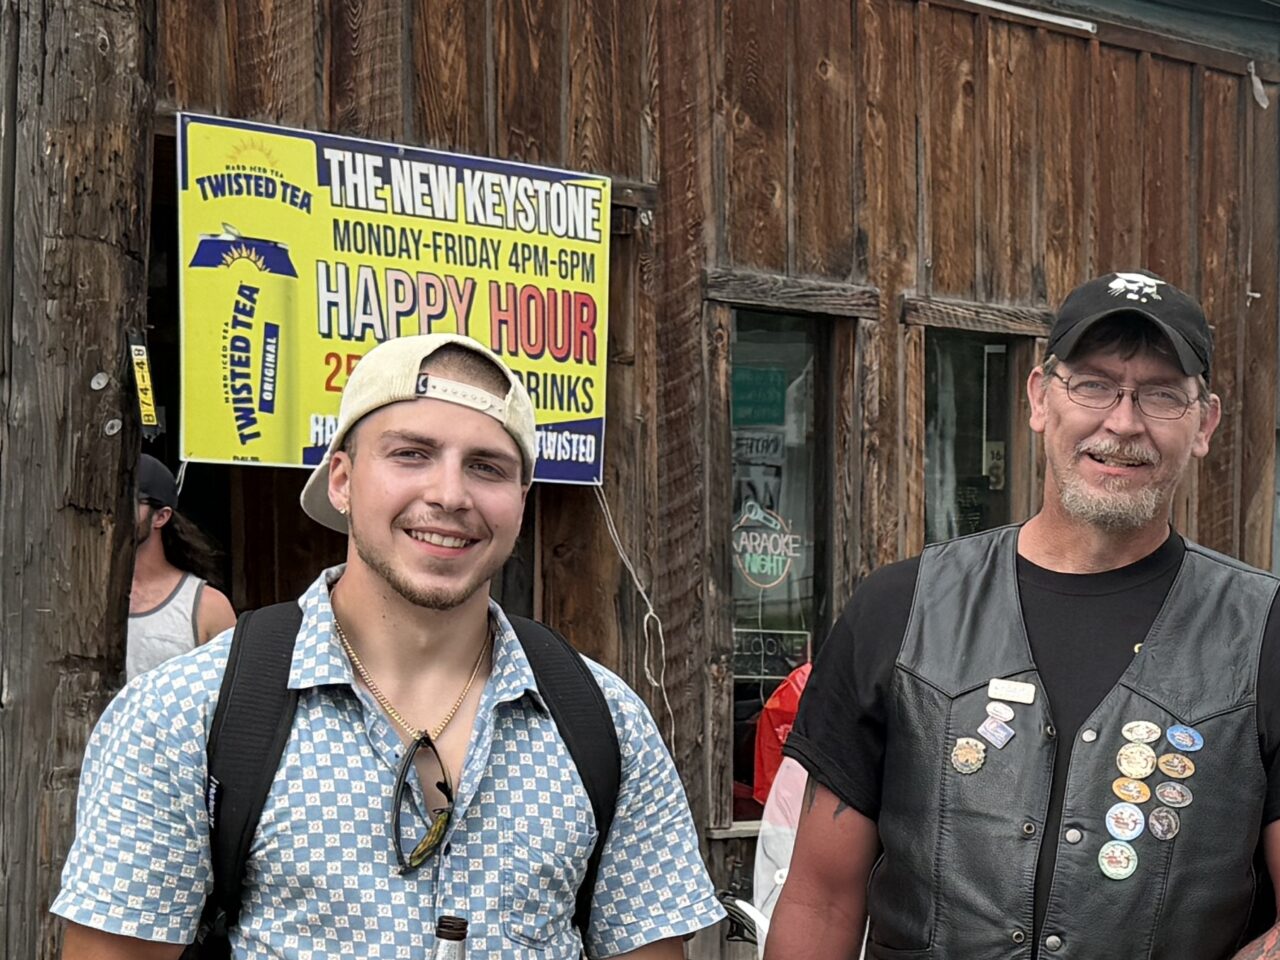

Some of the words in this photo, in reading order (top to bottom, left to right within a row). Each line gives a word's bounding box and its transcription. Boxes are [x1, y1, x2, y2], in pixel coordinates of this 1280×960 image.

[195, 172, 278, 201] TWISTED
[280, 180, 313, 215] TEA
[323, 148, 388, 213] THE
[389, 157, 458, 223] NEW
[462, 168, 602, 244] KEYSTONE
[332, 218, 502, 271] MONDAY-FRIDAY
[508, 242, 596, 284] 4PM-6PM
[231, 283, 261, 331] TEA
[315, 260, 476, 341] HAPPY
[488, 280, 598, 367] HOUR
[229, 335, 262, 446] TWISTED
[261, 336, 278, 401] ORIGINAL
[535, 430, 596, 464] TWISTED
[744, 552, 788, 577] NIGHT
[733, 635, 803, 657] ELCOME
